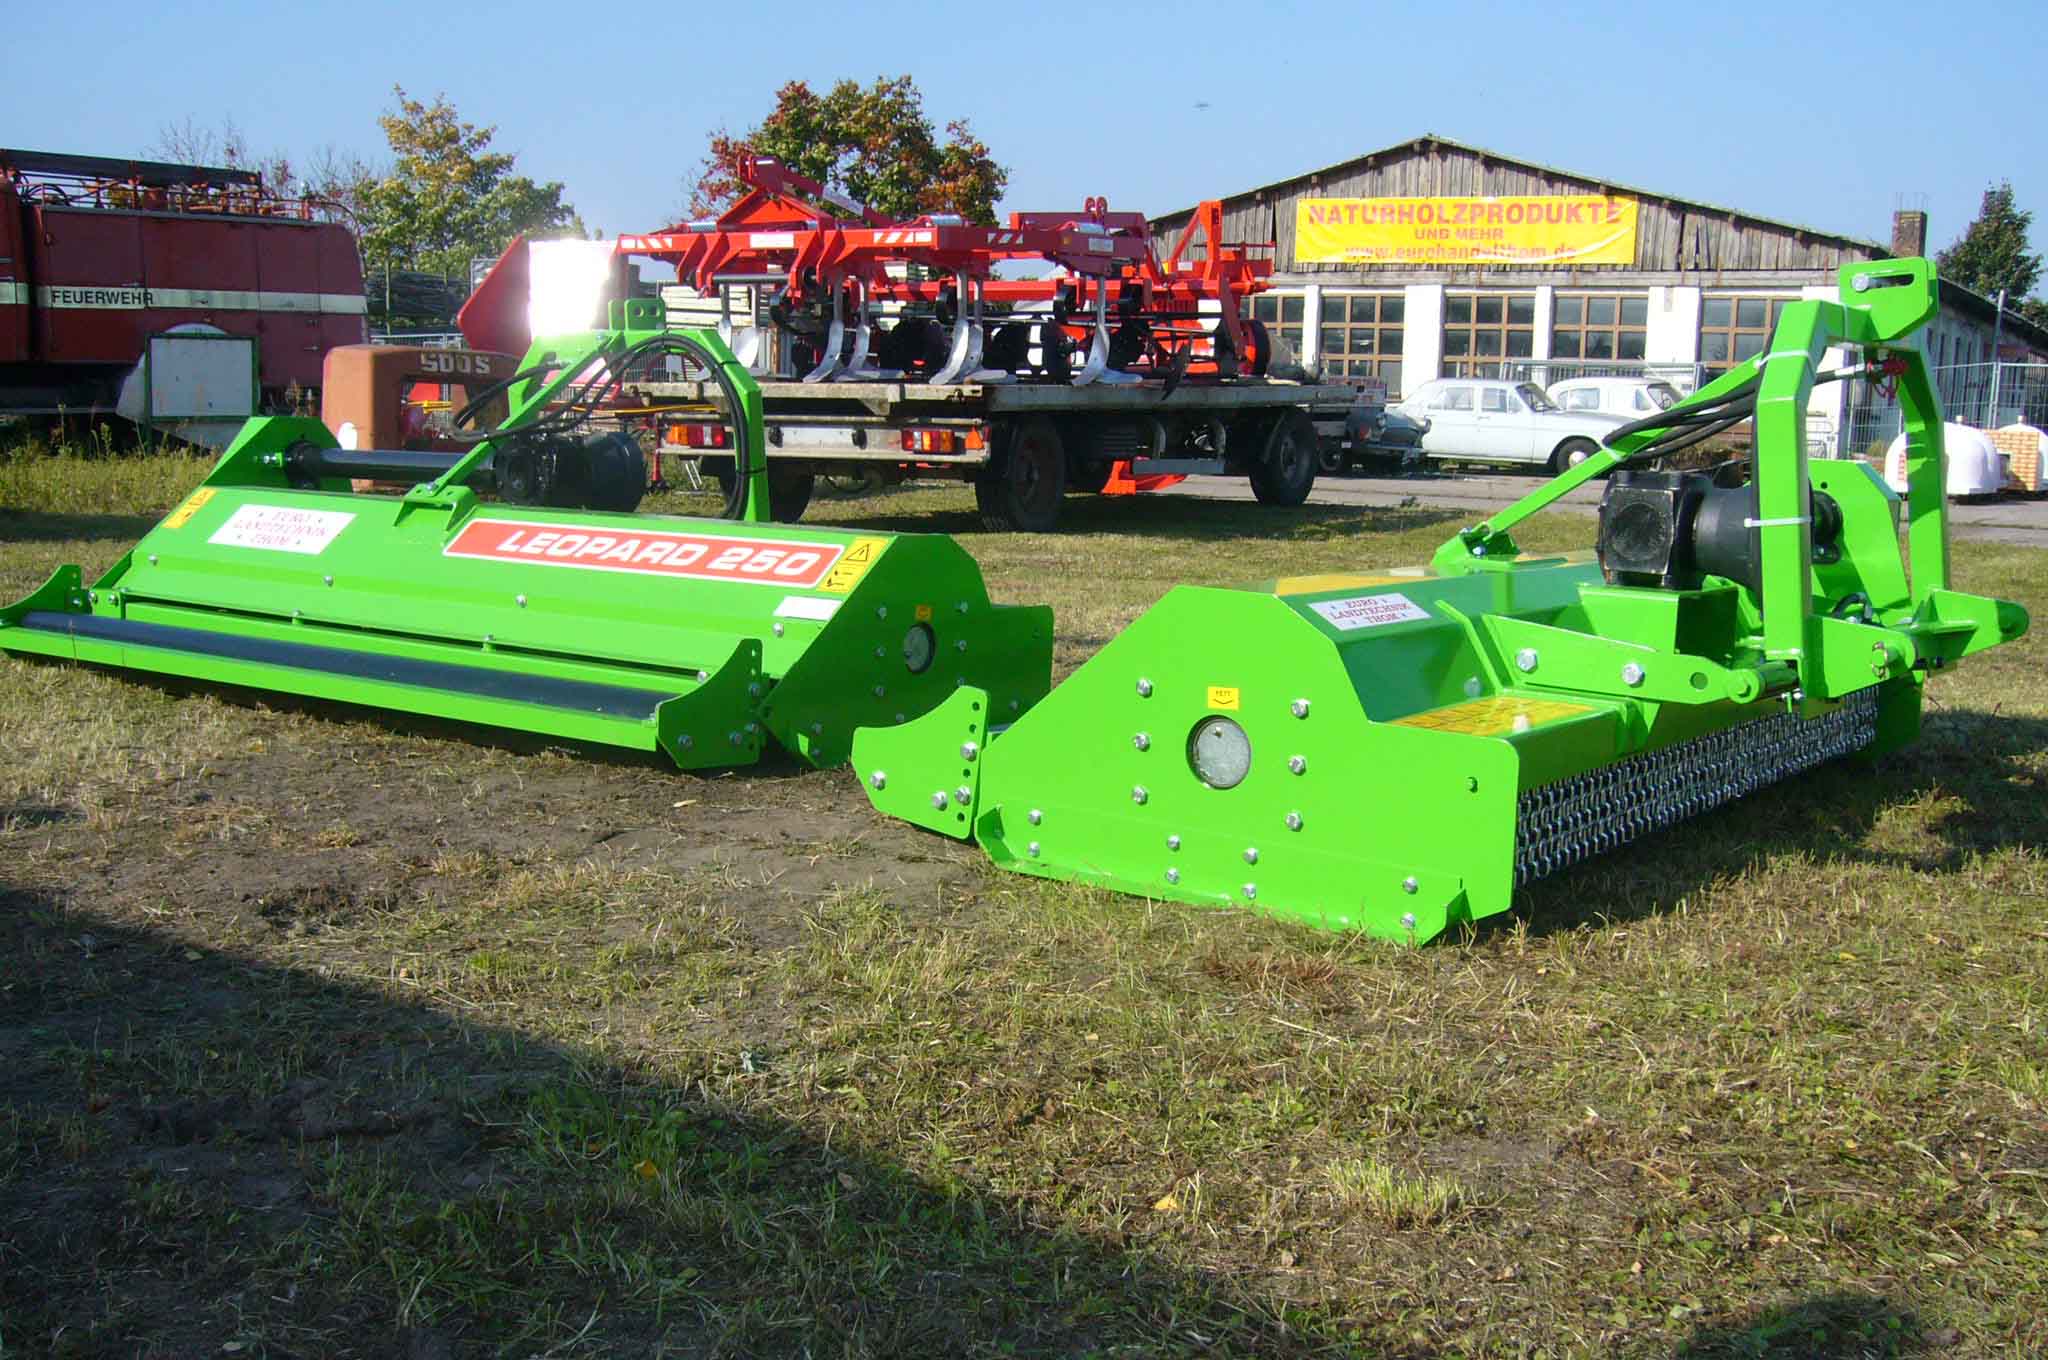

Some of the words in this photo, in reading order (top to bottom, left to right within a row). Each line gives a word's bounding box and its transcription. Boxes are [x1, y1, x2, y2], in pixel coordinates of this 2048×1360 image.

[1309, 203, 1623, 224] NATURHOLZPRODUKTE
[1455, 228, 1504, 240] MEHR
[51, 290, 154, 305] FEUERWEHR
[496, 530, 708, 567] LEOPARD
[706, 546, 822, 577] 250
[1329, 603, 1410, 620] LANDTECHNIK
[1345, 599, 1378, 609] EURO
